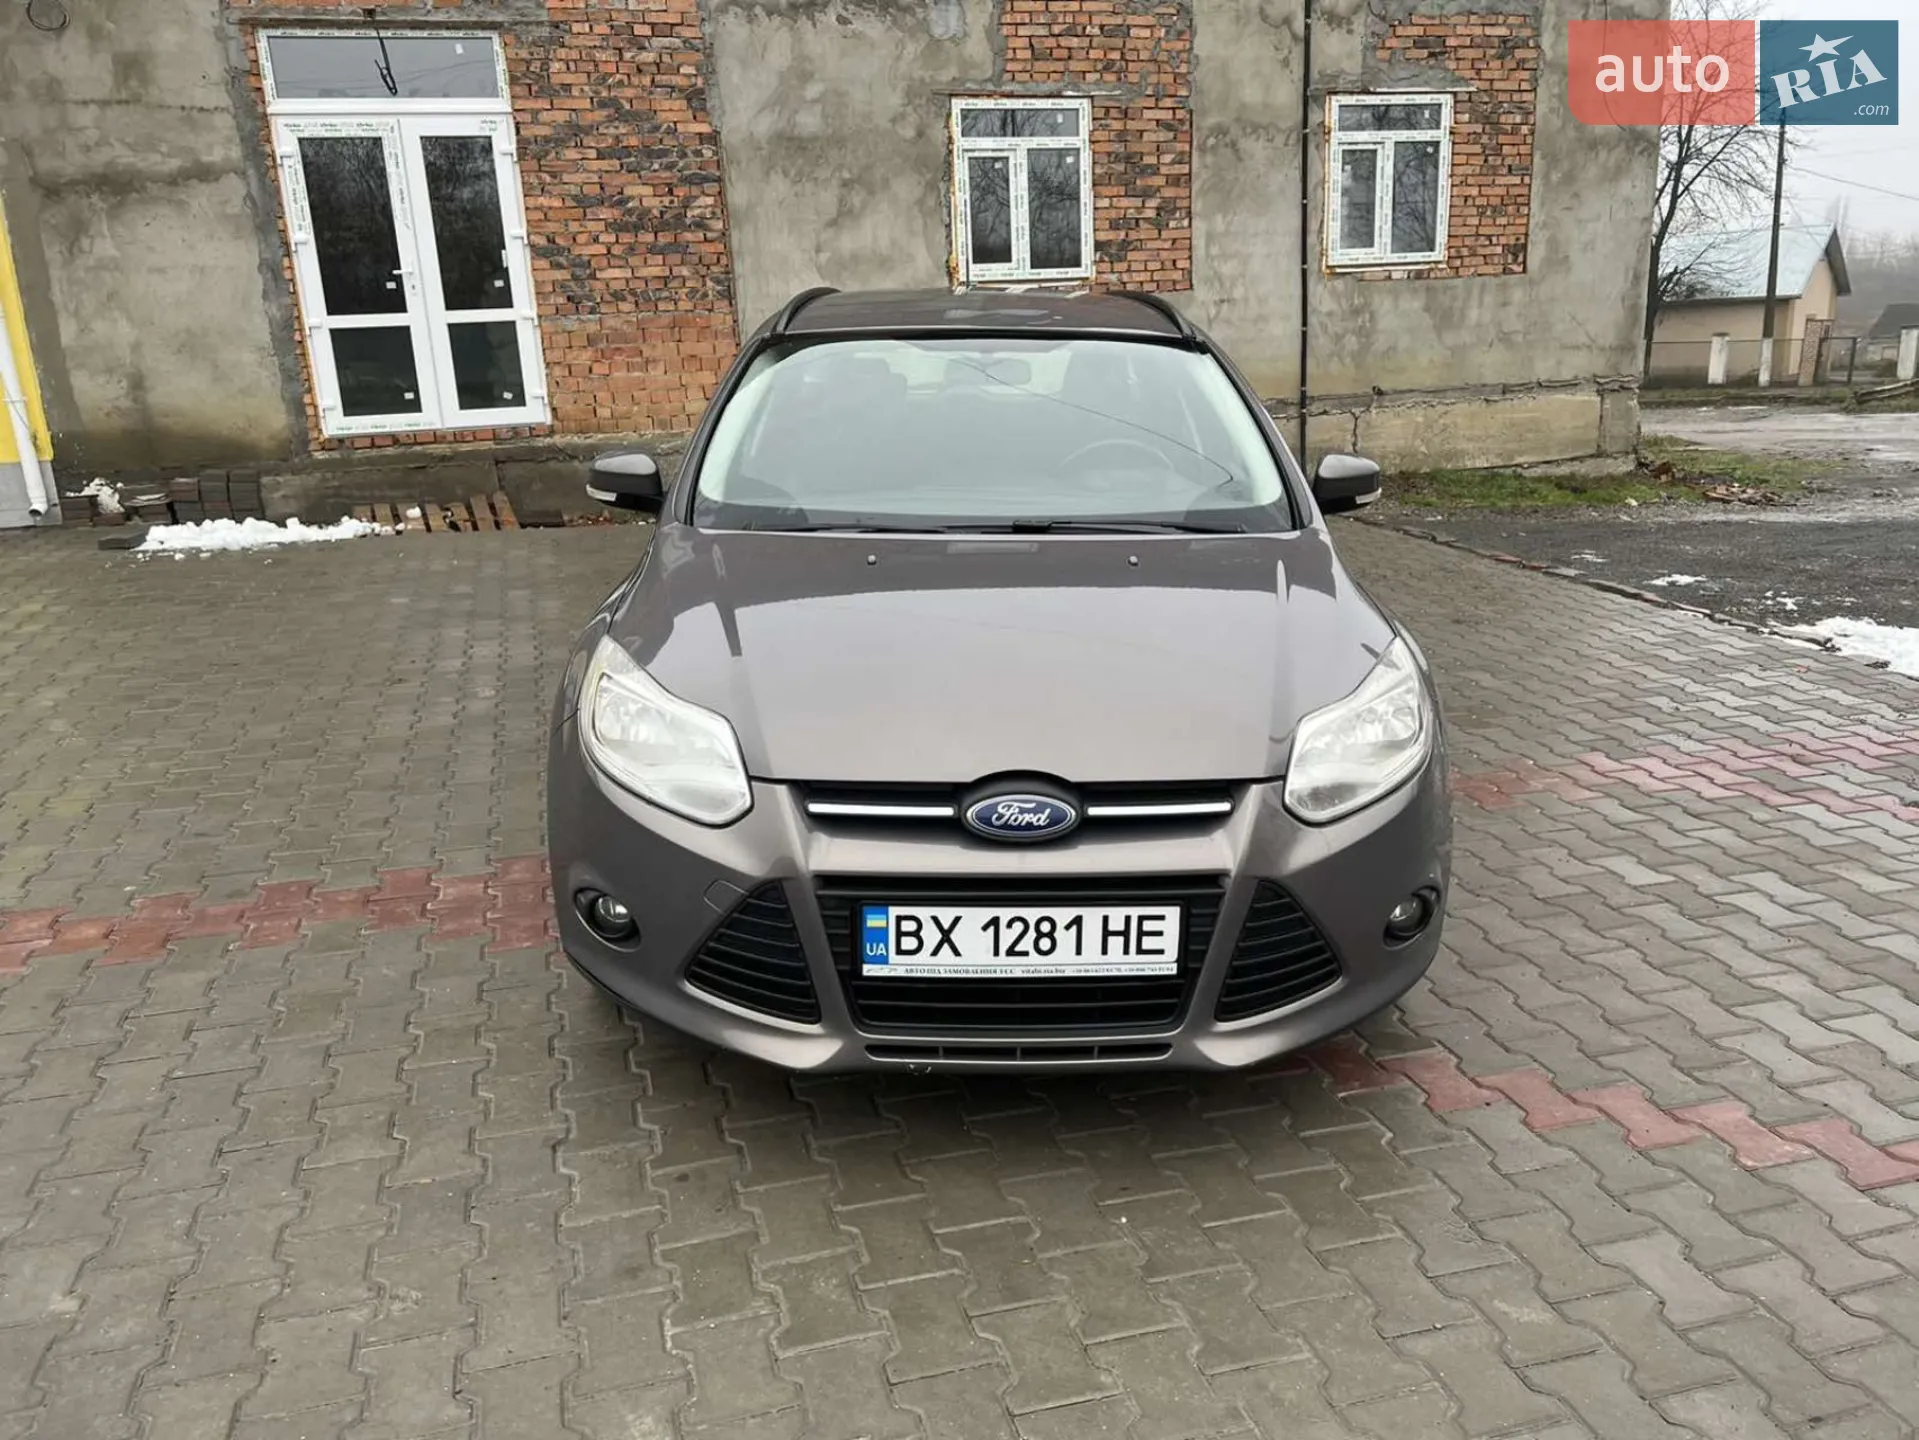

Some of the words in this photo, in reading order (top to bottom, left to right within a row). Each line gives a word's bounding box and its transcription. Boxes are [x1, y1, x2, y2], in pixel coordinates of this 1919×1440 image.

[991, 801, 1051, 827] Ford
[894, 915, 962, 957] BX
[981, 914, 1084, 957] 1281
[1101, 914, 1166, 956] HE
[866, 943, 887, 956] UA
